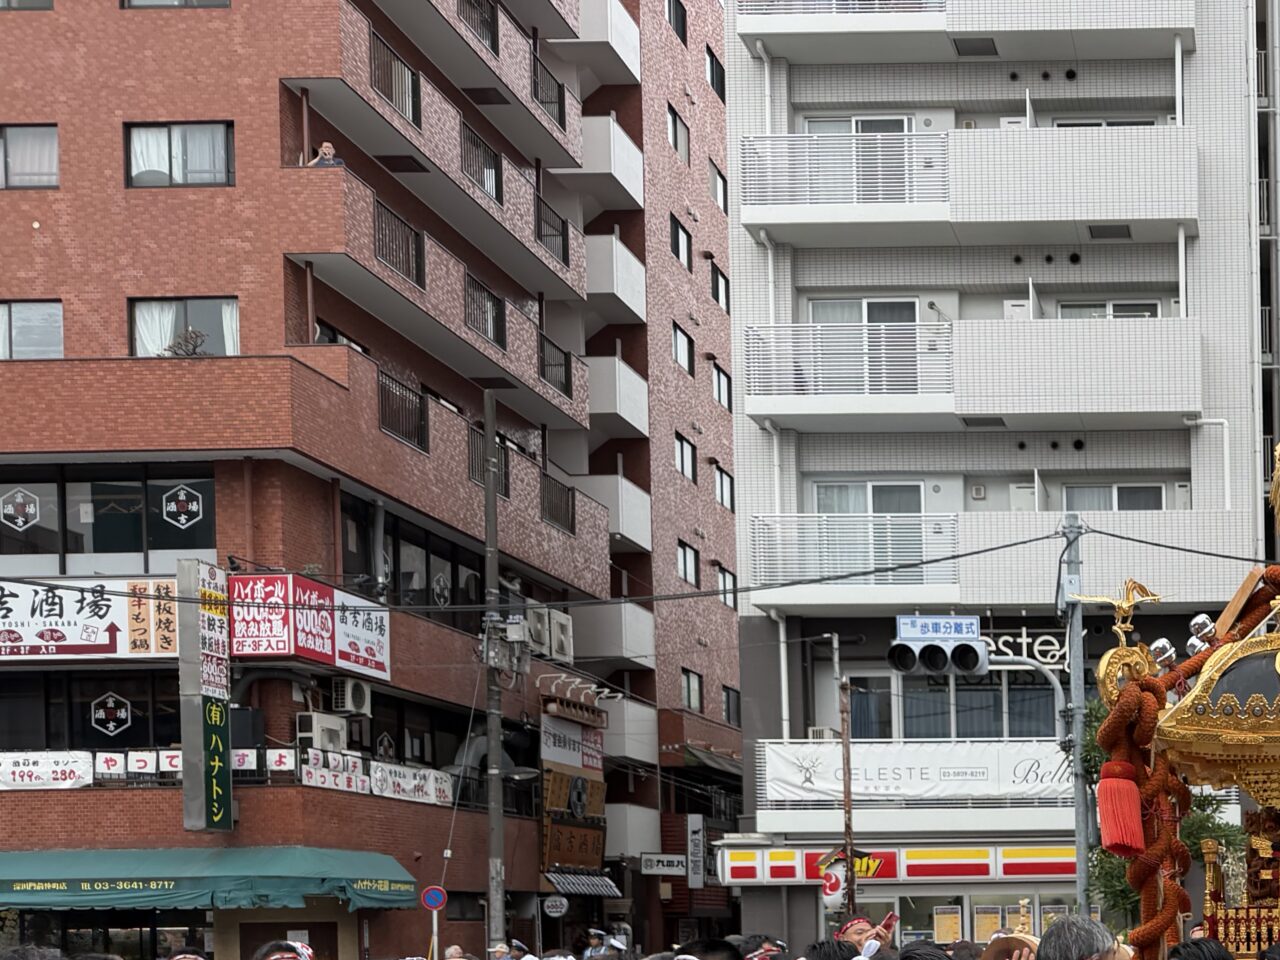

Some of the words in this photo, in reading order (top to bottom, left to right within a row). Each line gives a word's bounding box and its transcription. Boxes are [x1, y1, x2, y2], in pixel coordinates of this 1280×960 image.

[234, 579, 285, 599] ハイボール
[129, 584, 149, 650] 和牛もつ鍋
[155, 584, 175, 649] 鉄板焼き
[207, 615, 226, 634] 餃子
[340, 602, 385, 637] 富吉酒場
[234, 620, 286, 638] 飲み放題
[920, 622, 976, 635] 歩車分離式
[313, 753, 360, 774] ランチ
[210, 734, 224, 822] ハナトシ
[305, 769, 367, 792] やってます
